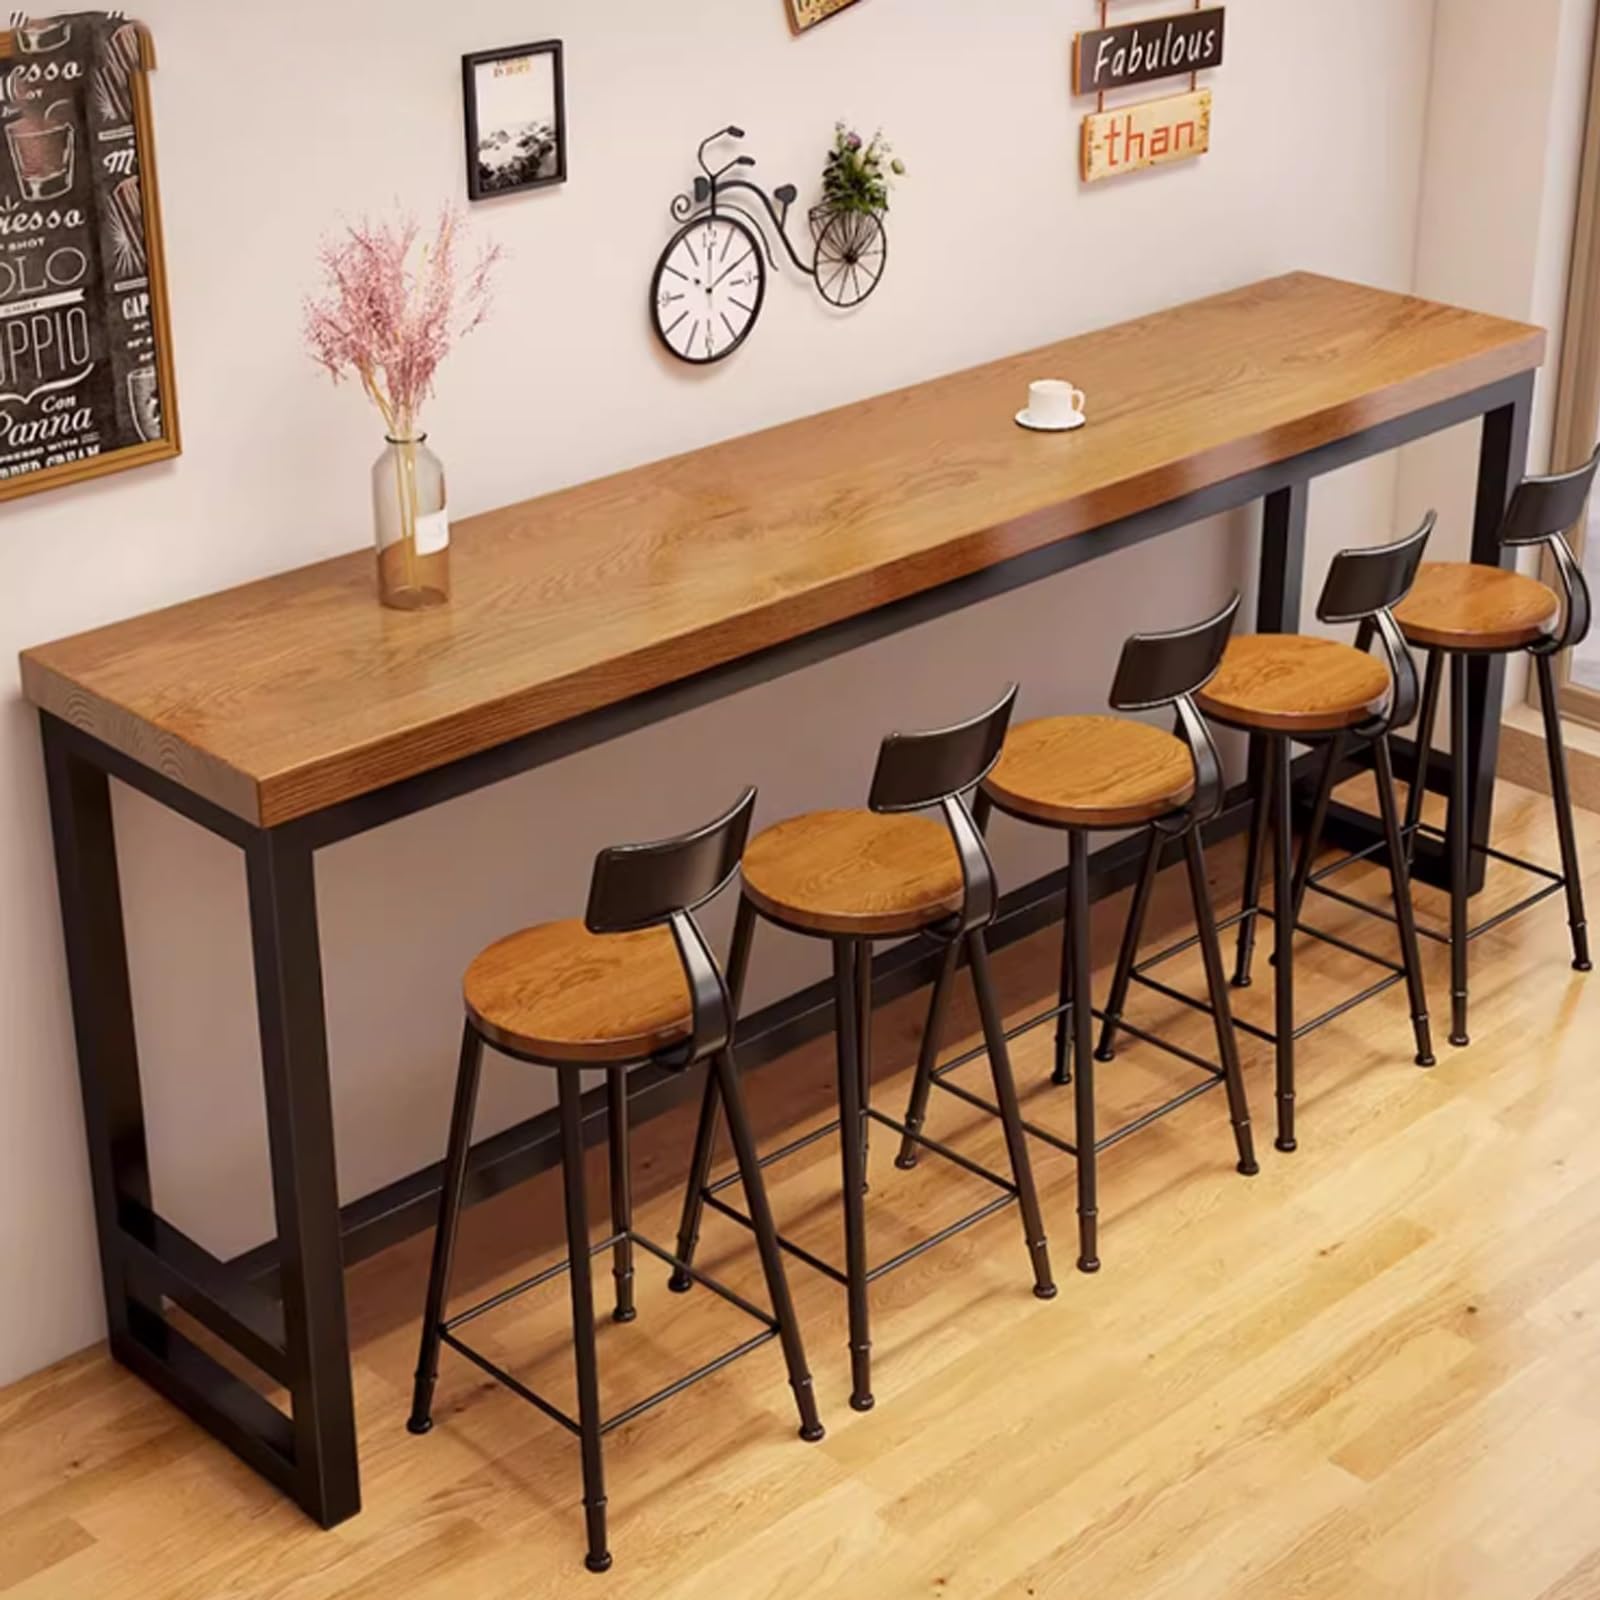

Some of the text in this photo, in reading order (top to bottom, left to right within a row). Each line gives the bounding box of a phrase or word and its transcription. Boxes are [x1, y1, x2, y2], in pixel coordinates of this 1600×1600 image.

[1093, 22, 1216, 83] Fabulous
[1104, 115, 1195, 166] than
[0, 306, 91, 387] PPIO
[41, 394, 77, 413] Con
